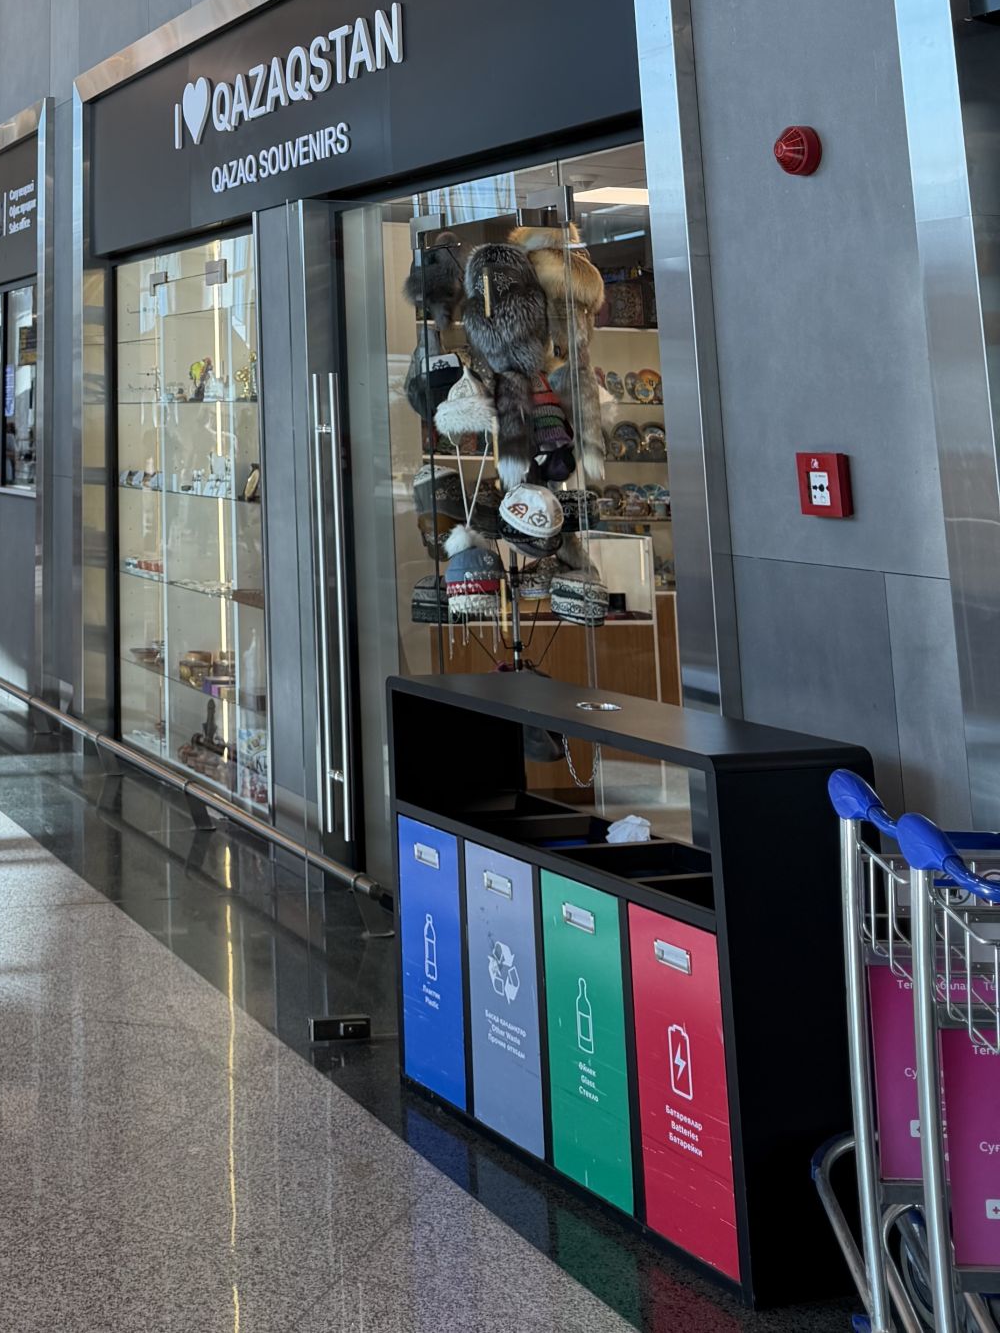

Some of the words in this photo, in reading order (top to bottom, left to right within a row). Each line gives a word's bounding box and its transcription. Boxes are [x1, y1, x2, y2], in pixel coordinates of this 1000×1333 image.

[174, 103, 183, 150] I
[211, 2, 404, 132] QAZAQSTAN
[211, 154, 258, 193] QAZAQ
[258, 122, 350, 179] SOUVENIRS
[580, 1075, 596, 1089] Glass
[578, 1086, 599, 1103] Стекло
[671, 1120, 699, 1142] Batteries
[668, 1132, 703, 1158] Батарейки
